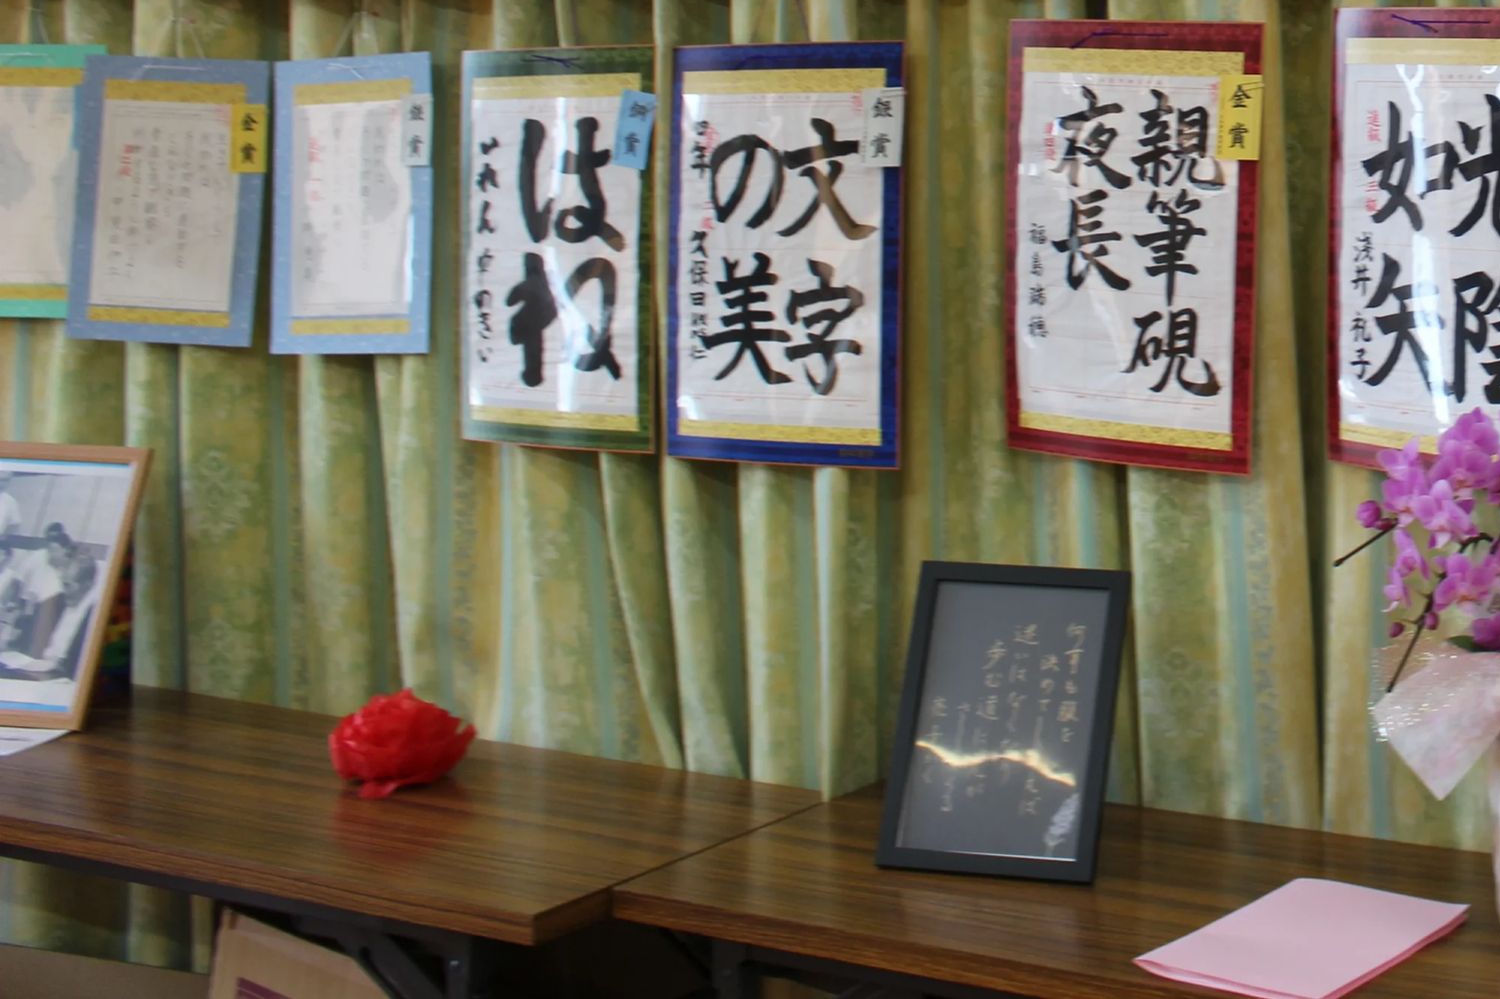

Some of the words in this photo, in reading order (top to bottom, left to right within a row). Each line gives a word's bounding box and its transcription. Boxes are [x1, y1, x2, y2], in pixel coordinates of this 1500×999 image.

[240, 112, 259, 164] 金賞
[870, 97, 894, 158] 銀賞
[1052, 86, 1132, 291] 夜長
[1227, 84, 1252, 149] 金賞
[506, 117, 626, 388] はね
[700, 133, 793, 385] の美
[777, 117, 878, 395] 文字
[1361, 100, 1459, 396] 如矢
